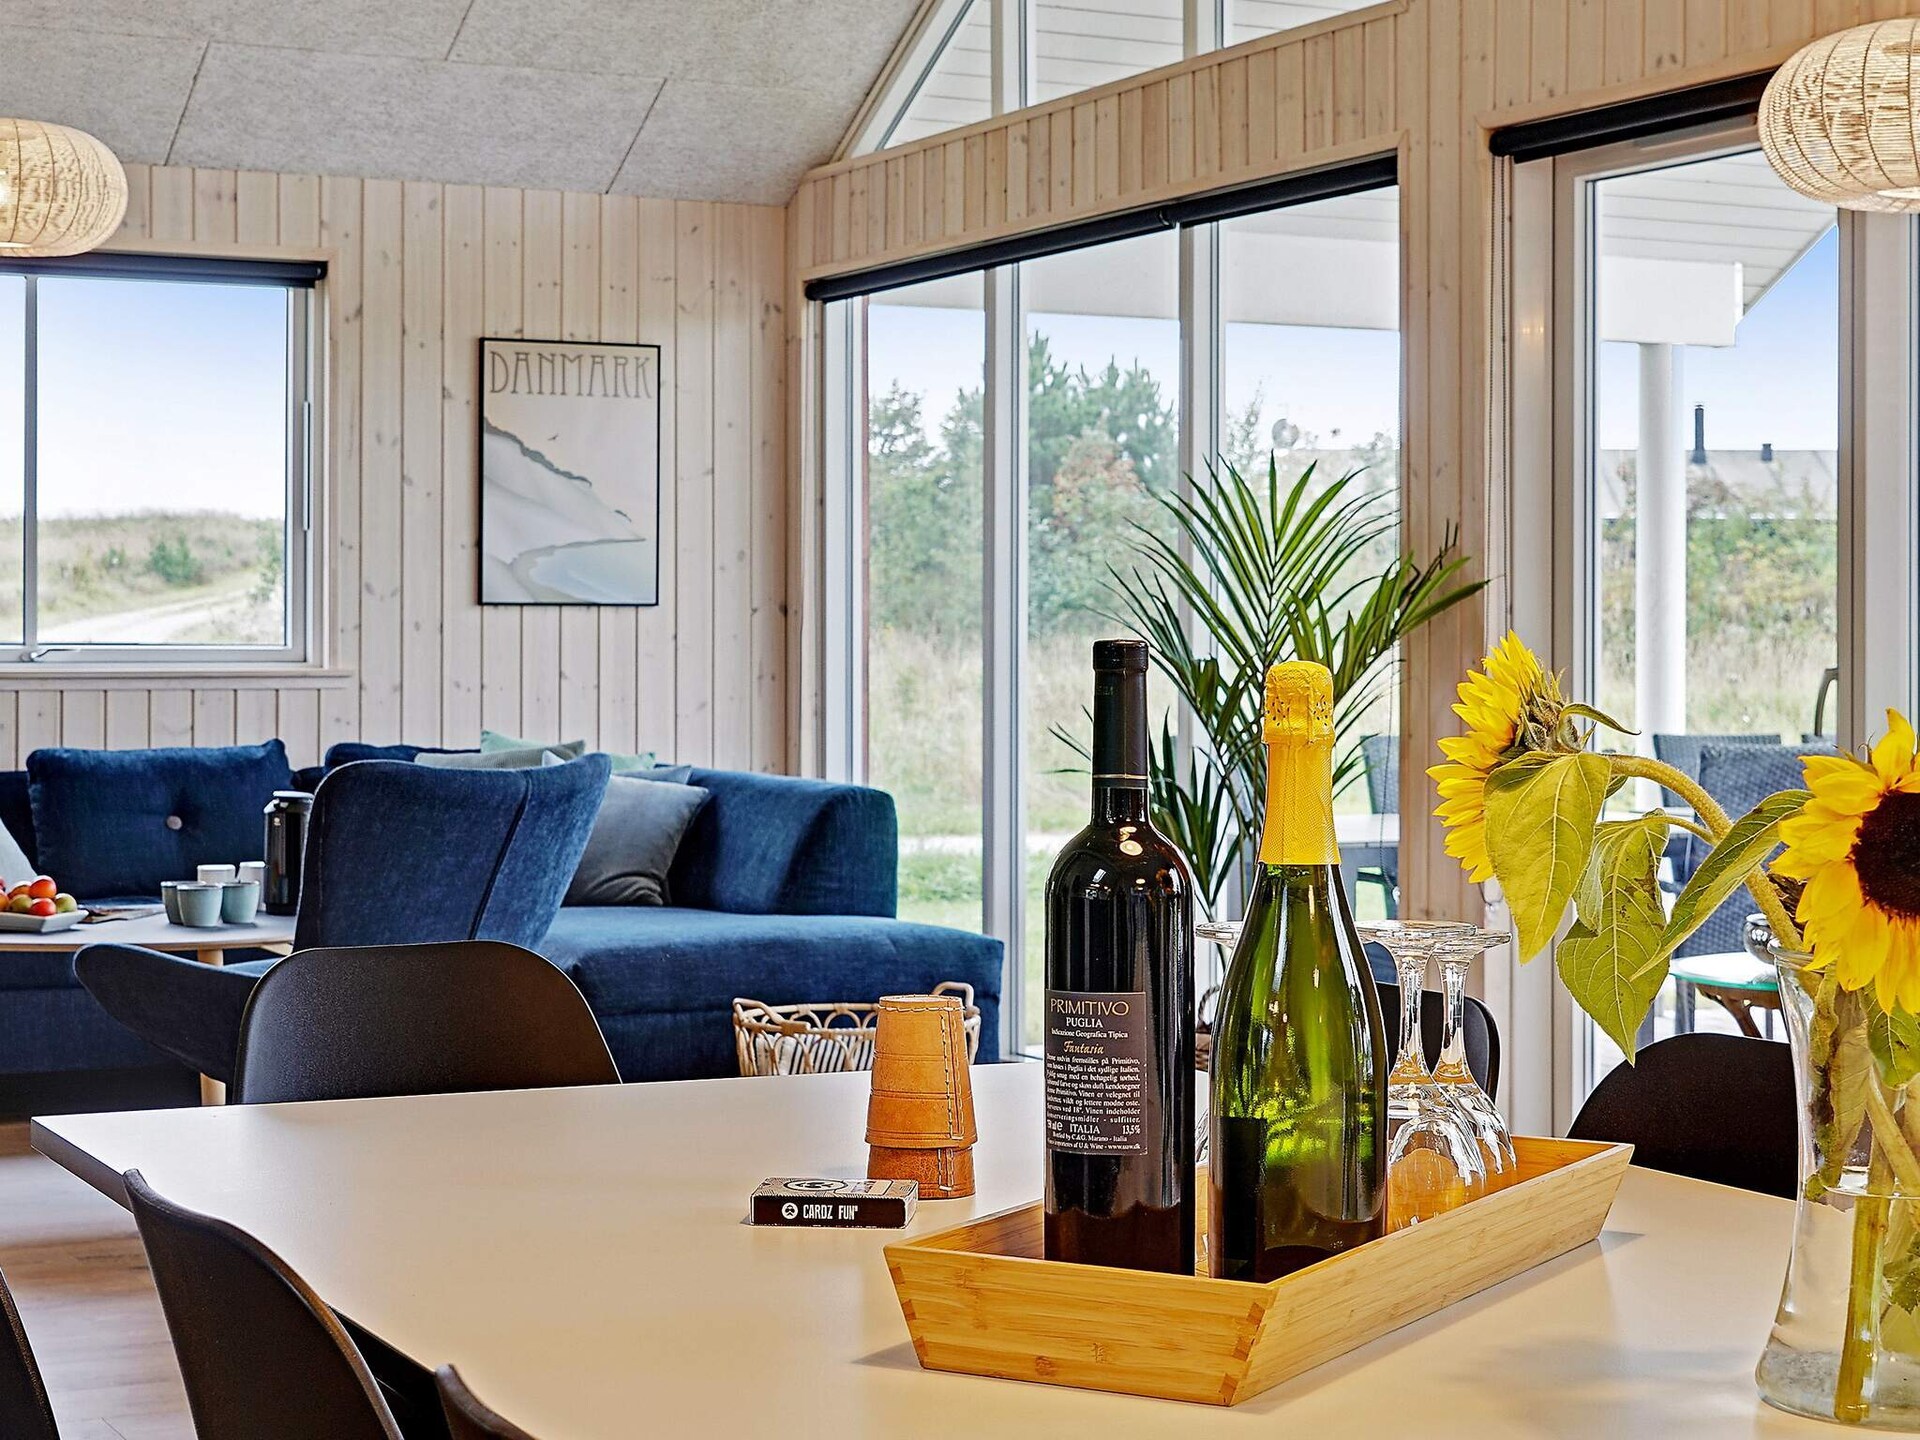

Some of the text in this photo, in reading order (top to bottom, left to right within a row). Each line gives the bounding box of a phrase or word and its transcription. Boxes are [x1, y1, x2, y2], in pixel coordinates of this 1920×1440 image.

[490, 351, 652, 399] DANMARK
[1050, 998, 1129, 1016] PRIMITIVO
[1065, 1017, 1104, 1028] PUGLIA
[1075, 1030, 1107, 1039] Geografica
[1108, 1031, 1128, 1040] Tipica
[1063, 1040, 1104, 1054] Fantasia
[1101, 1057, 1109, 1066] på
[1067, 1064, 1083, 1073] Puglia
[1087, 1065, 1097, 1073] det
[1097, 1065, 1119, 1074] sydlige
[1090, 1073, 1118, 1082] behagelig
[1071, 1082, 1078, 1090] og
[1105, 1082, 1140, 1091] kendetegner
[1078, 1089, 1095, 1098] Vinen
[1106, 1091, 1131, 1099] velegnet
[1106, 1107, 1140, 1115] indeholder
[1069, 1123, 1101, 1134] ITALIA
[1089, 1142, 1104, 1150] Wine
[802, 1204, 834, 1220] CARDZ
